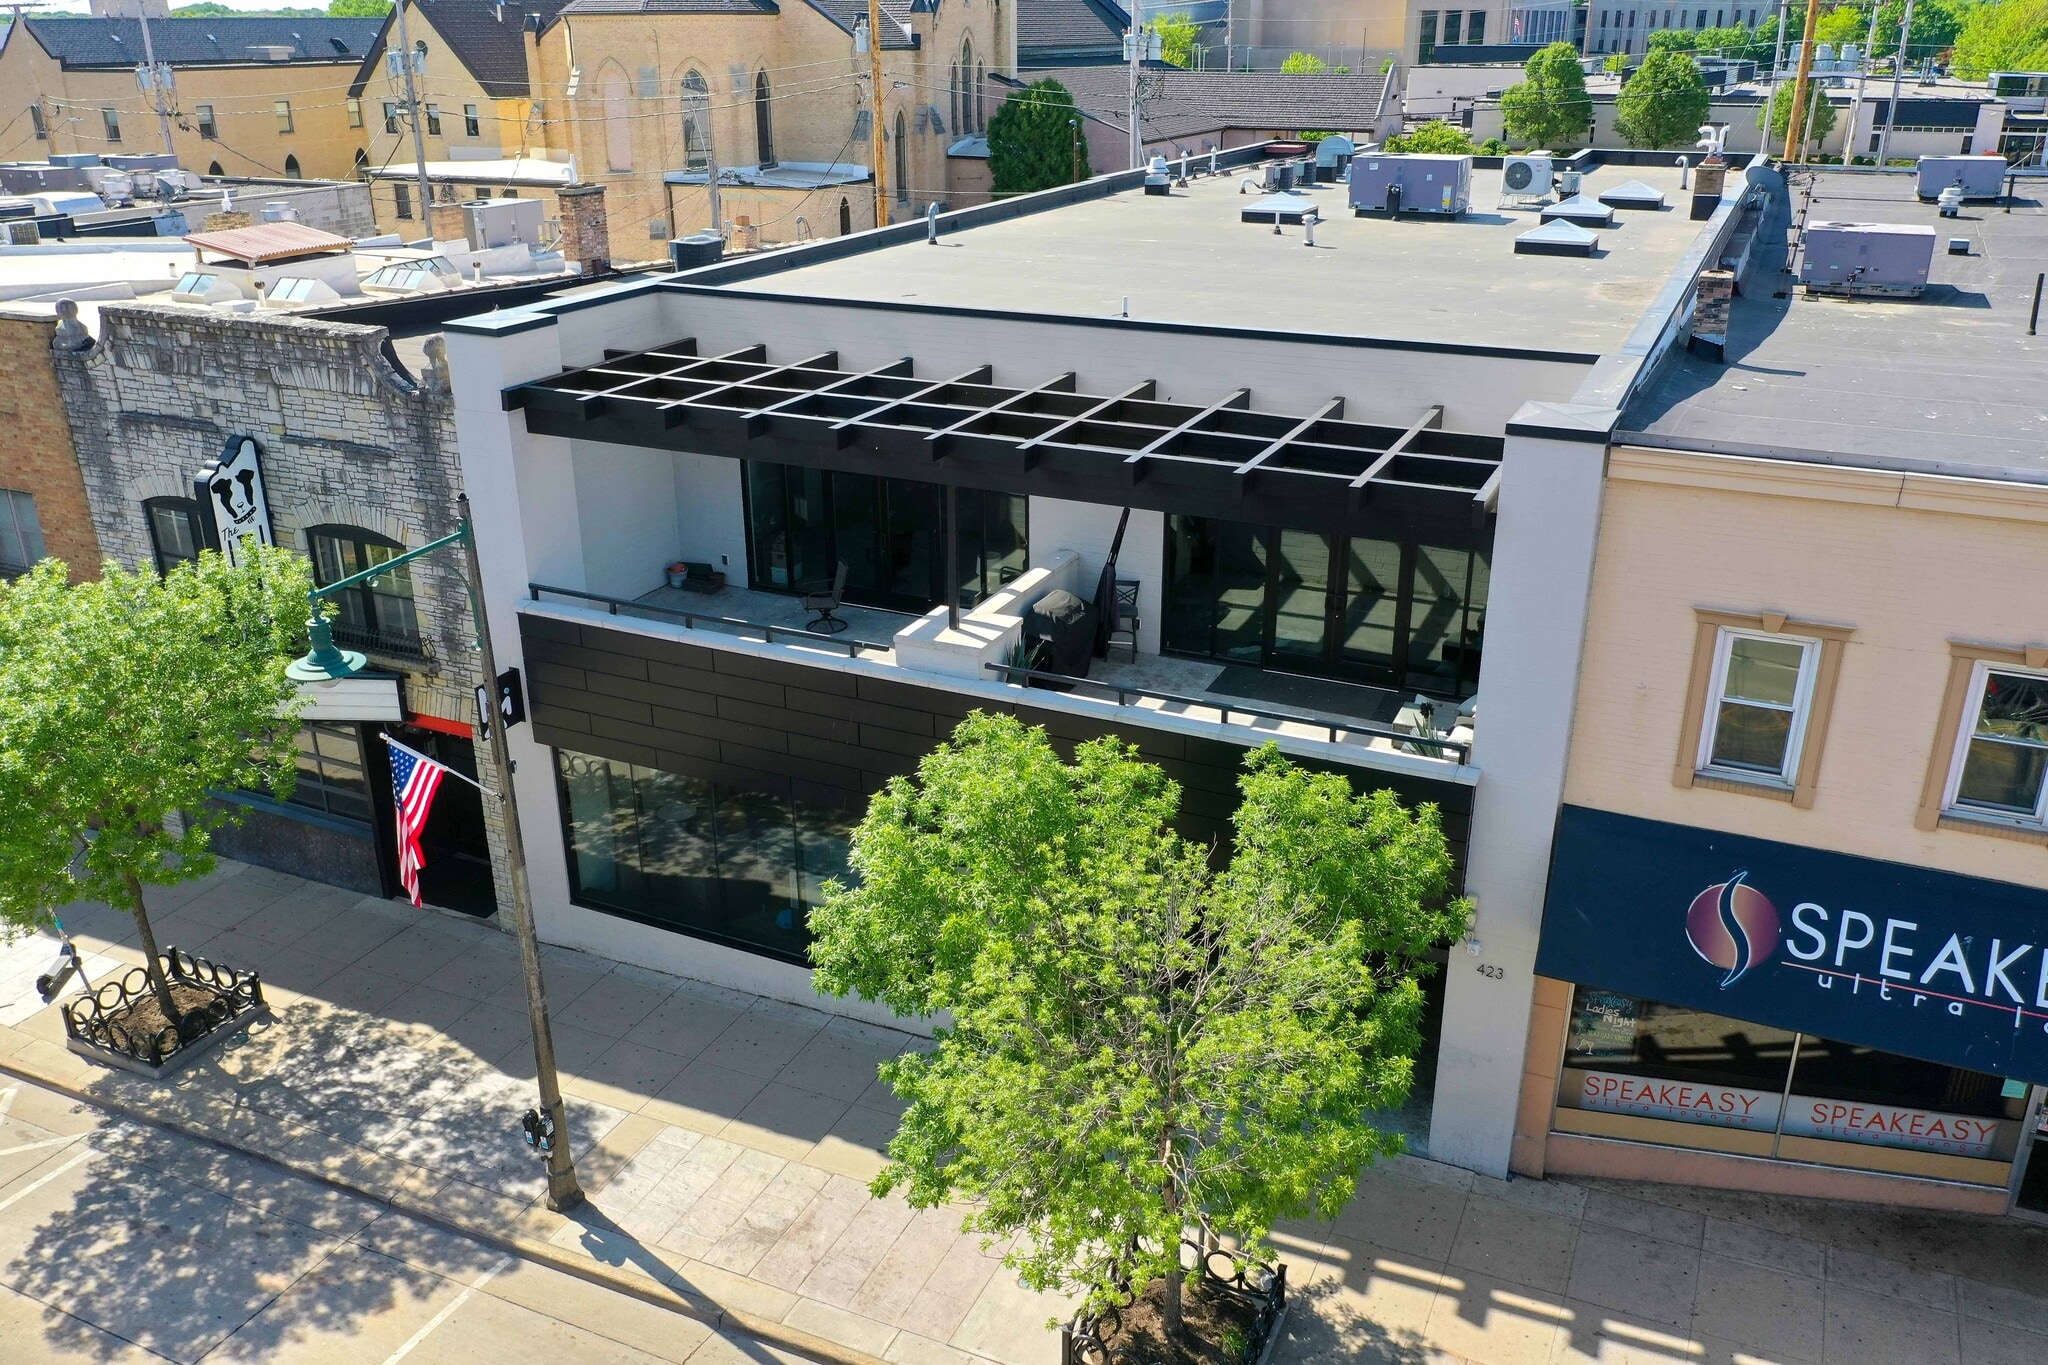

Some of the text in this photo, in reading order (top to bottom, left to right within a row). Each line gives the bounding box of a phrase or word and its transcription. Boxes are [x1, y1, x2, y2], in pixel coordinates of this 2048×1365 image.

[221, 527, 239, 541] The
[1476, 964, 1504, 980] 423
[1817, 973, 1963, 1016] ultra
[1586, 1003, 1620, 1017] Ladies
[1603, 1014, 1636, 1027] Night
[1584, 1076, 1760, 1114] SPEAKEASY
[1589, 1098, 1748, 1124] ultra lounge
[1810, 1103, 1997, 1142] SPEAKEASY
[1815, 1126, 1880, 1139] ultra
